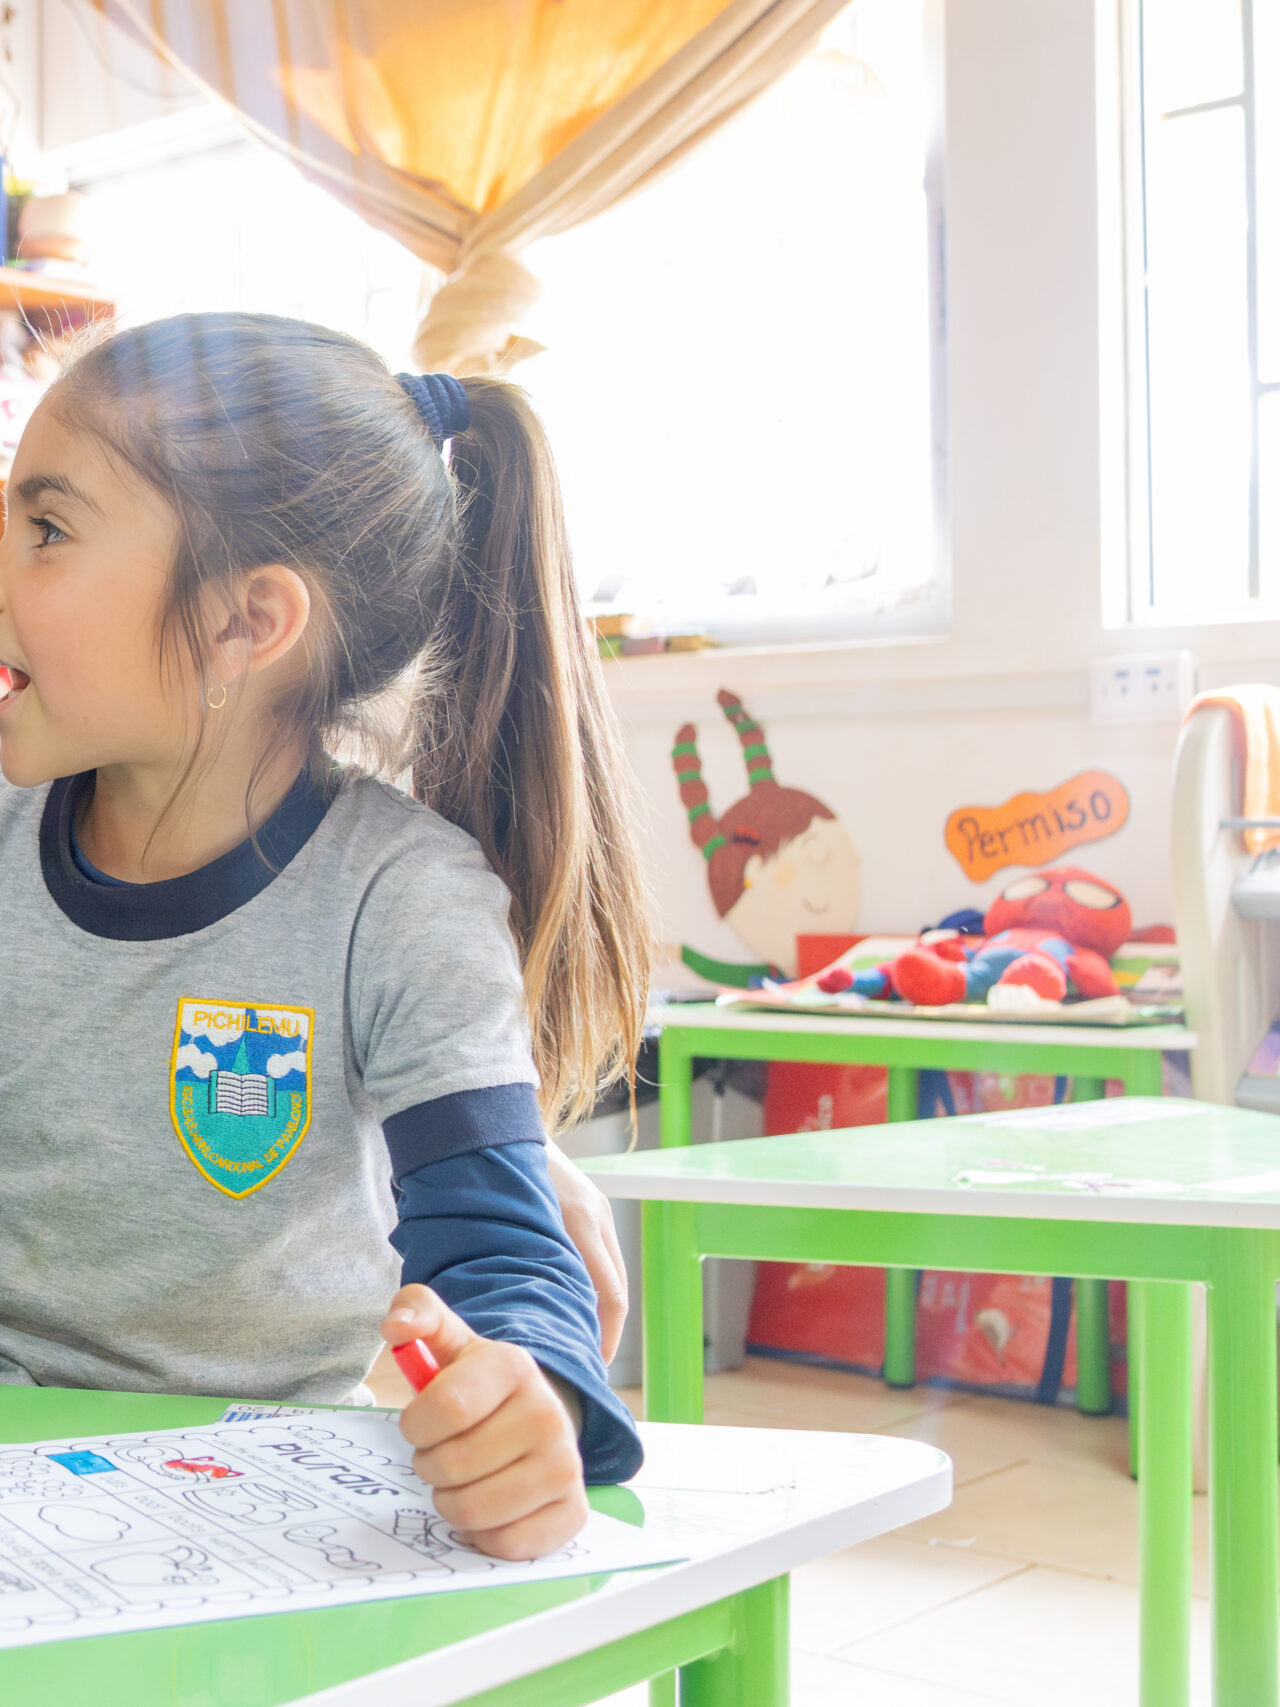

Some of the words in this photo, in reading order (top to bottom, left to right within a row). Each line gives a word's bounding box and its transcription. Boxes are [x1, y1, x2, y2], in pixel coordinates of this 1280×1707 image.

[957, 790, 1112, 863] Permiso
[193, 1010, 300, 1038] PICHILEMU
[257, 1441, 400, 1497] plurals
